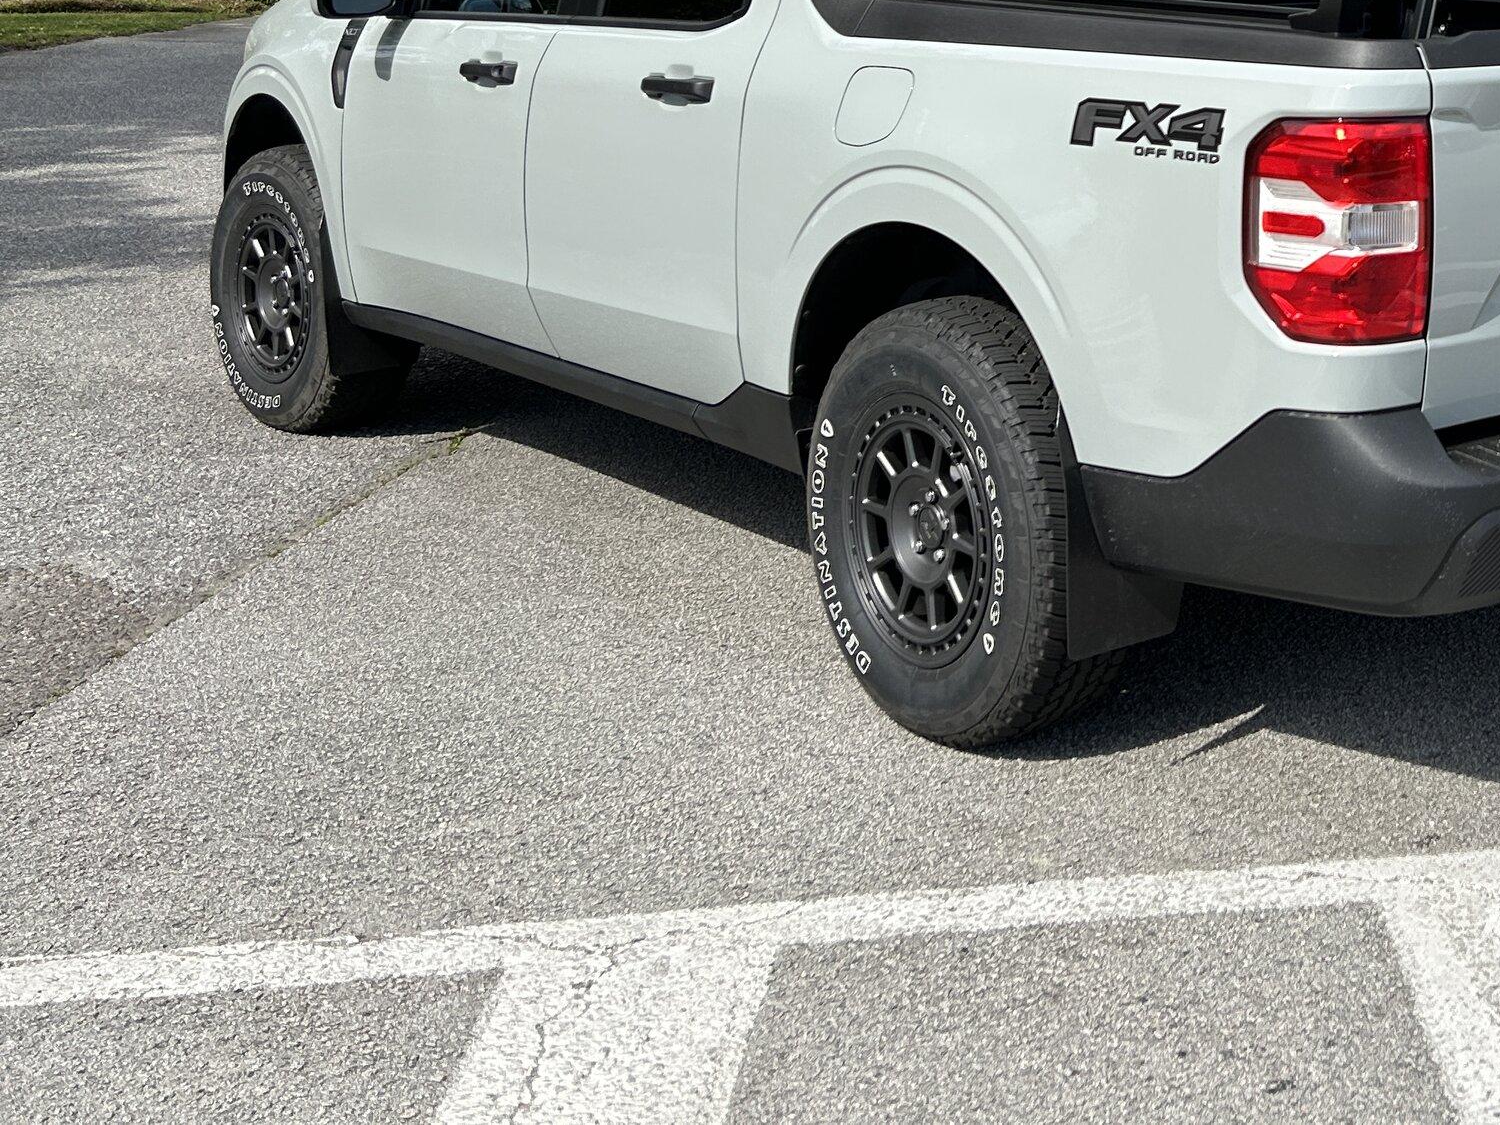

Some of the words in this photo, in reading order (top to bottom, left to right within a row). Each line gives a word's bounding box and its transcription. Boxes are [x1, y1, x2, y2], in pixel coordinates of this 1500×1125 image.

[1070, 97, 1227, 152] FX4
[1134, 146, 1168, 159] OFF
[1173, 149, 1221, 164] ROAD
[811, 443, 872, 675] DESTINATION
